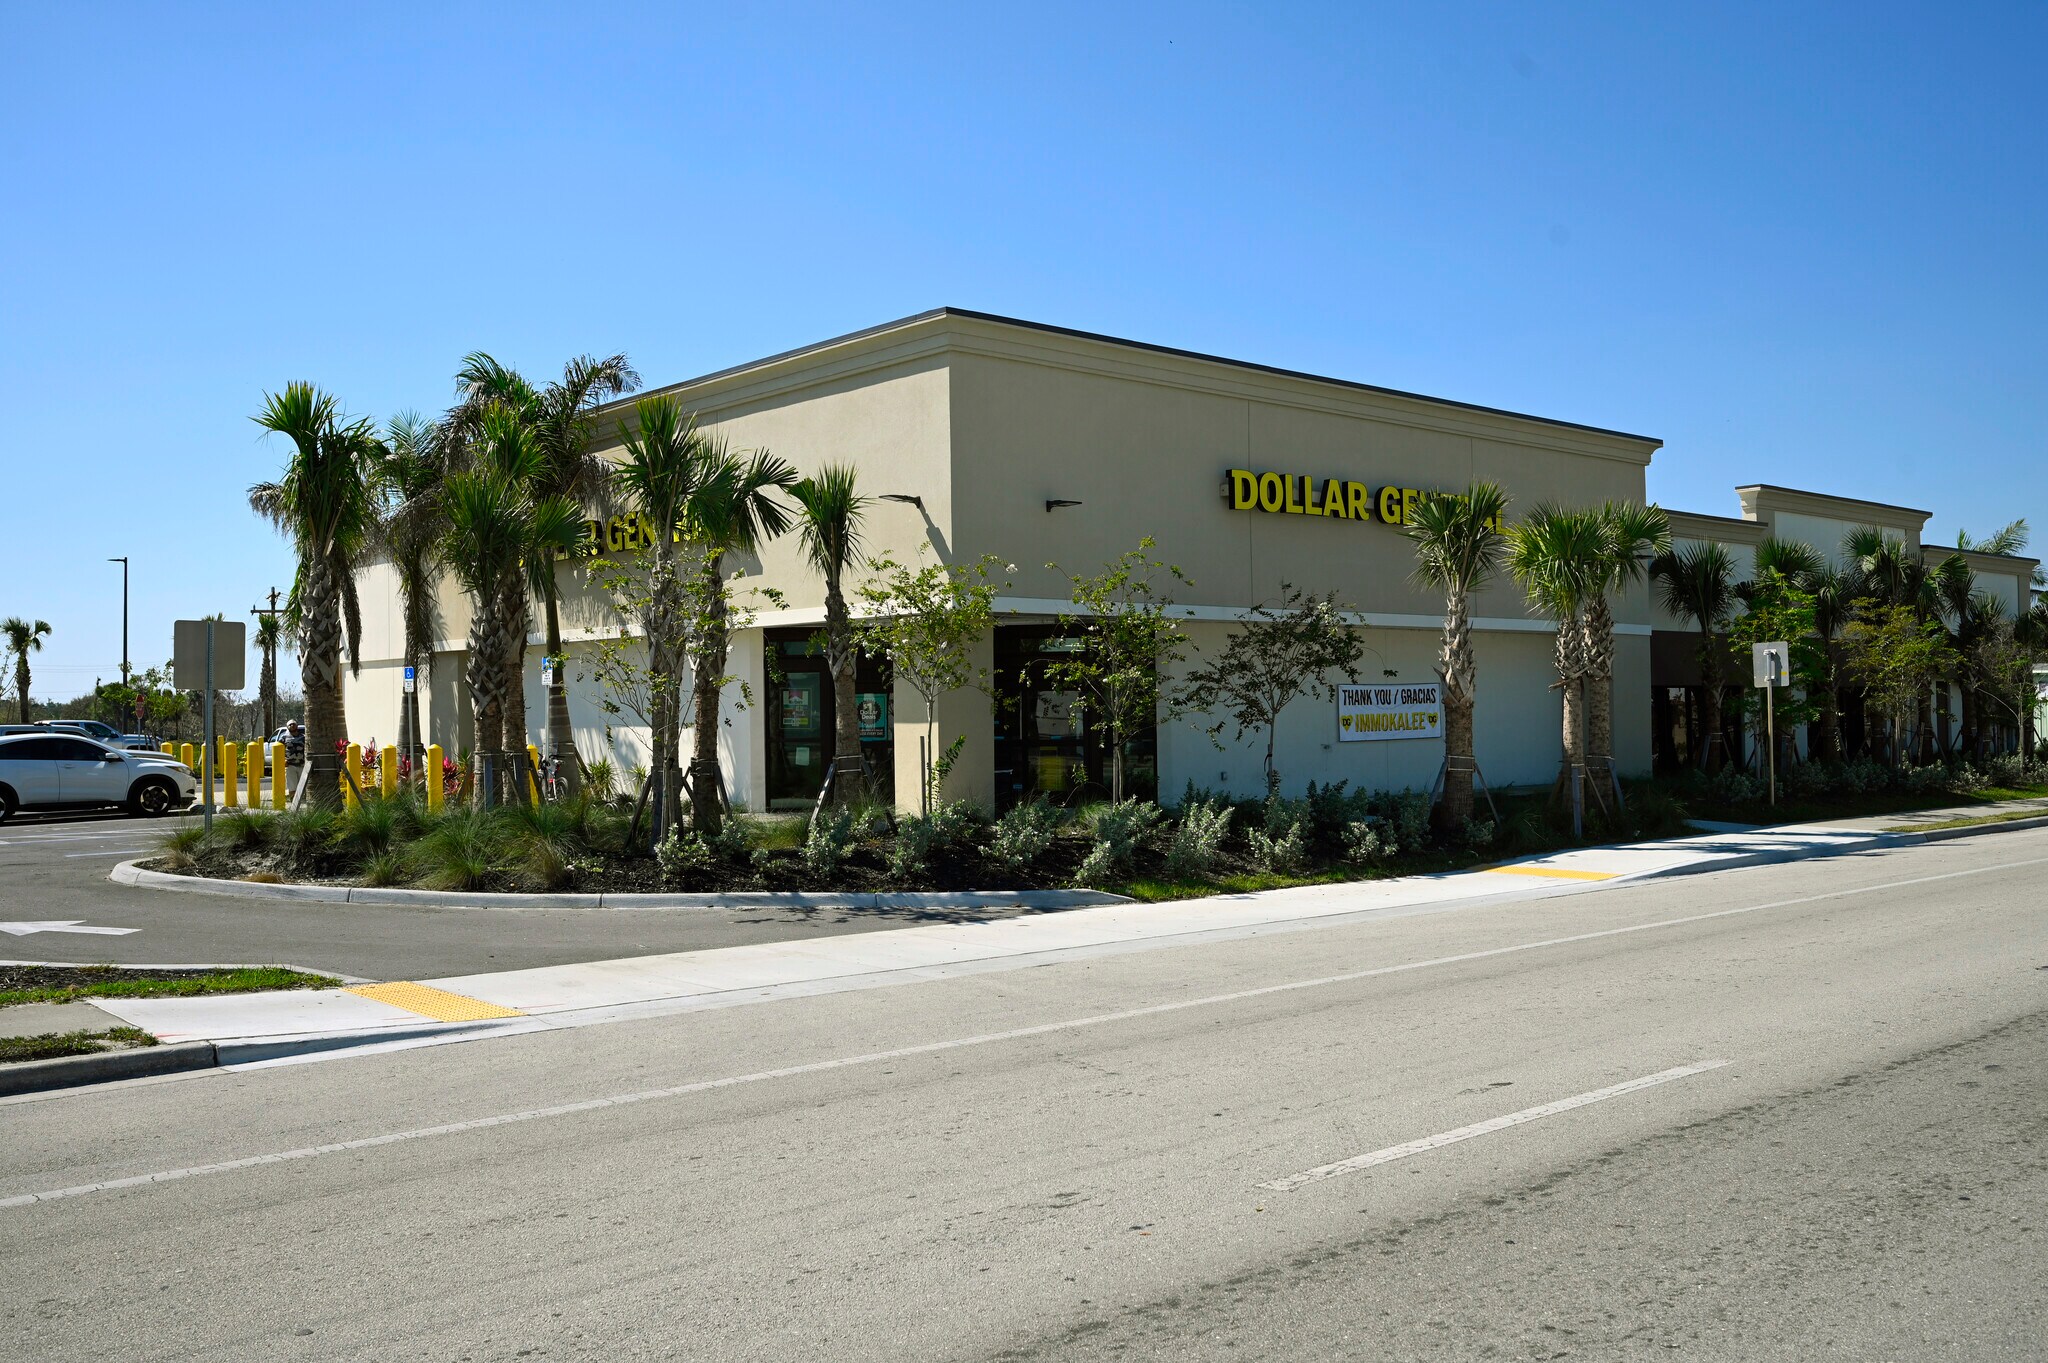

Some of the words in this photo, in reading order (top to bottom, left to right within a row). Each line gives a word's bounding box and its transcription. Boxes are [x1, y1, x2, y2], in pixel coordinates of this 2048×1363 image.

[1228, 468, 1370, 521] DOLLAR
[1342, 689, 1372, 705] THANK
[1374, 689, 1391, 705] YOU
[1401, 688, 1436, 704] GRACIAS
[1342, 718, 1351, 726] DG
[1355, 712, 1426, 732] IMMOKALEE
[1428, 715, 1437, 723] DG
